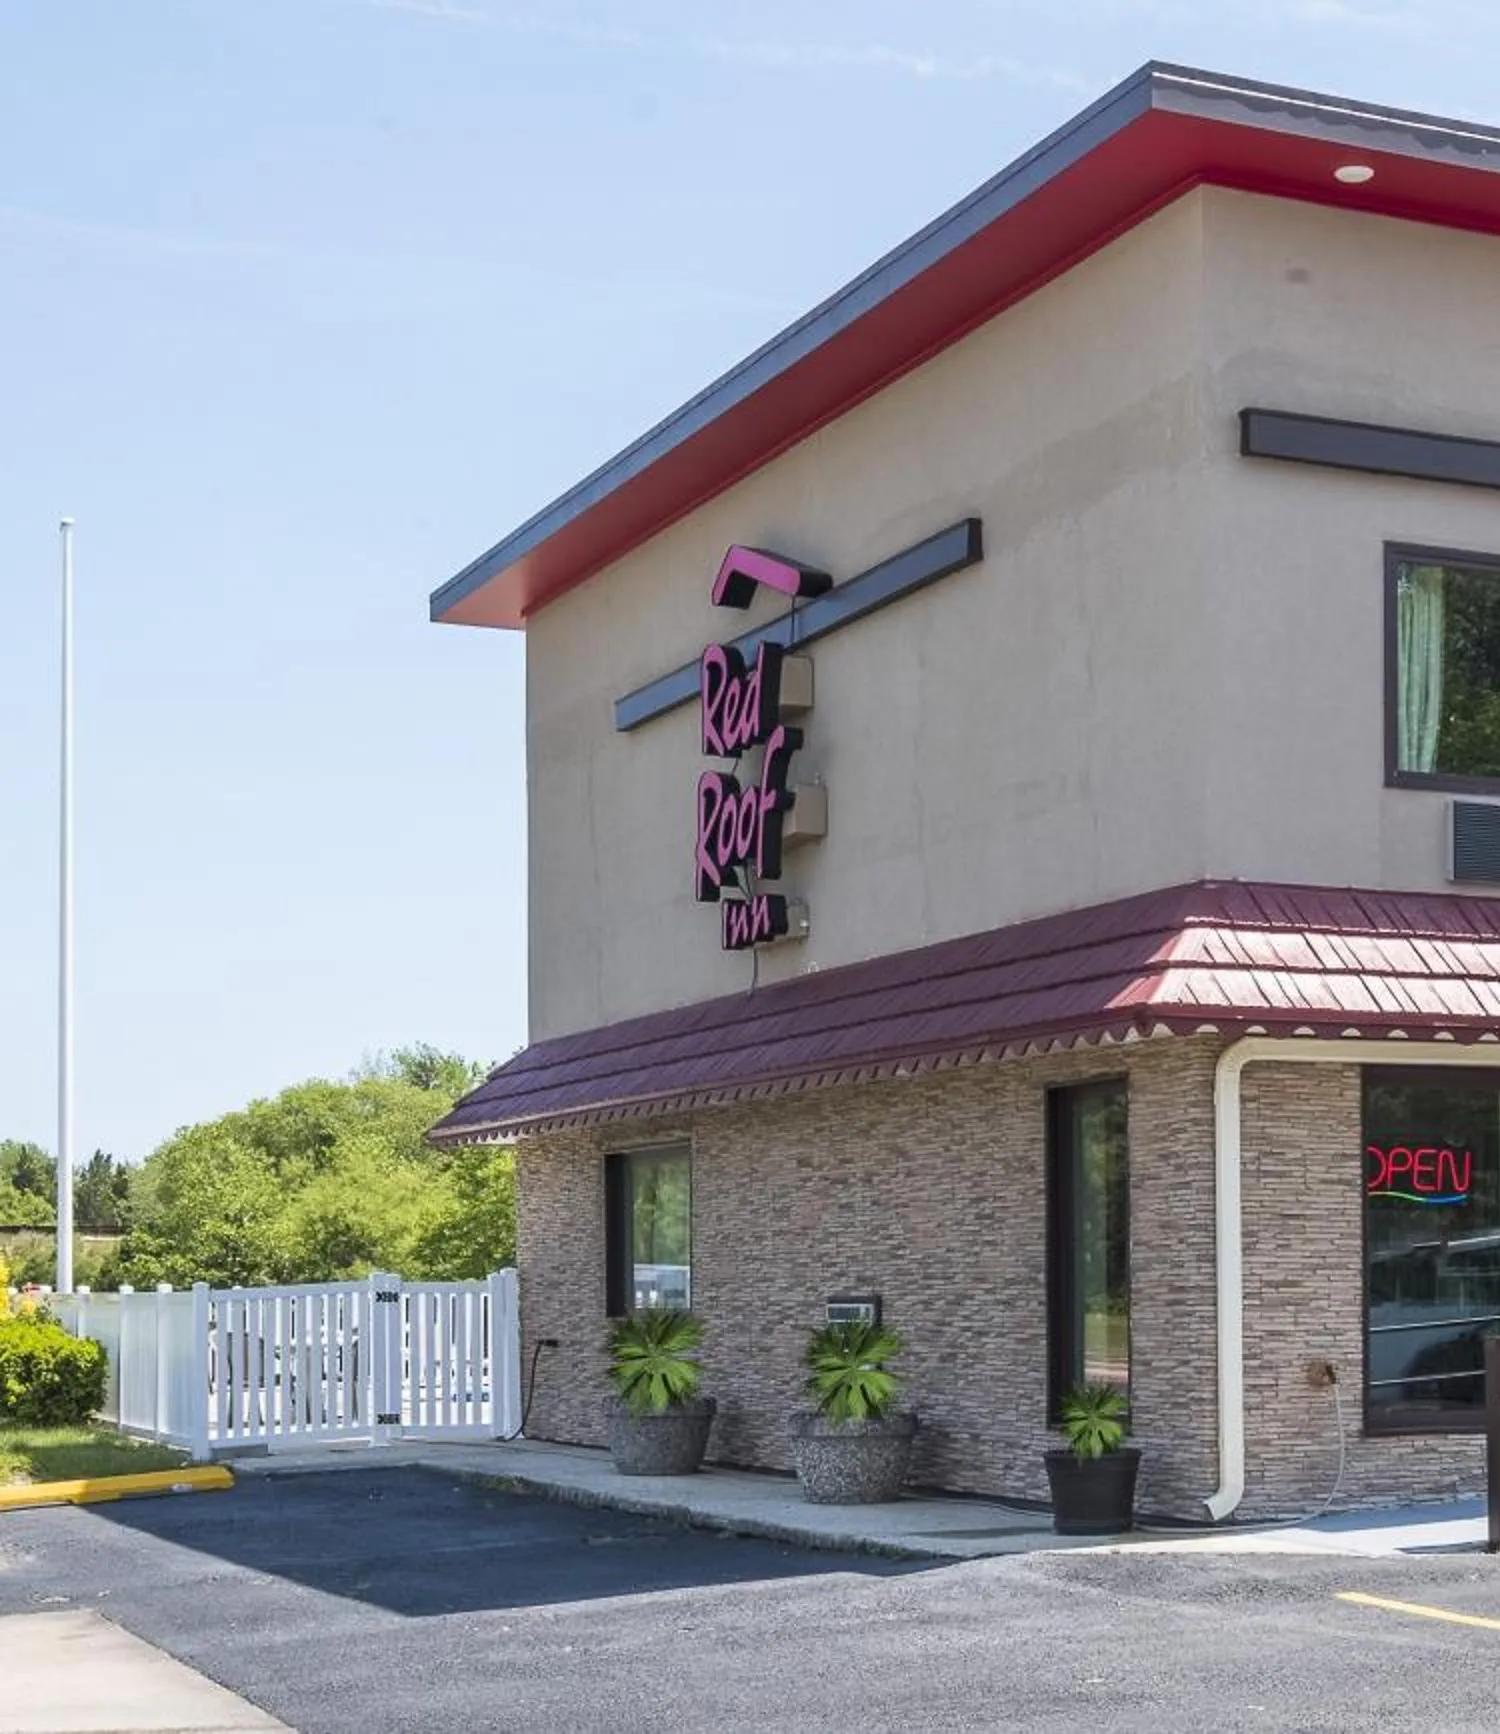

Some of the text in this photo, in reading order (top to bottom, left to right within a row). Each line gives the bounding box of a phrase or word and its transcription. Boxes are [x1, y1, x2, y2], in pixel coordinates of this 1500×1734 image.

[703, 640, 766, 757] Red
[696, 725, 786, 899] Roof
[1366, 1146, 1471, 1192] OPEN
